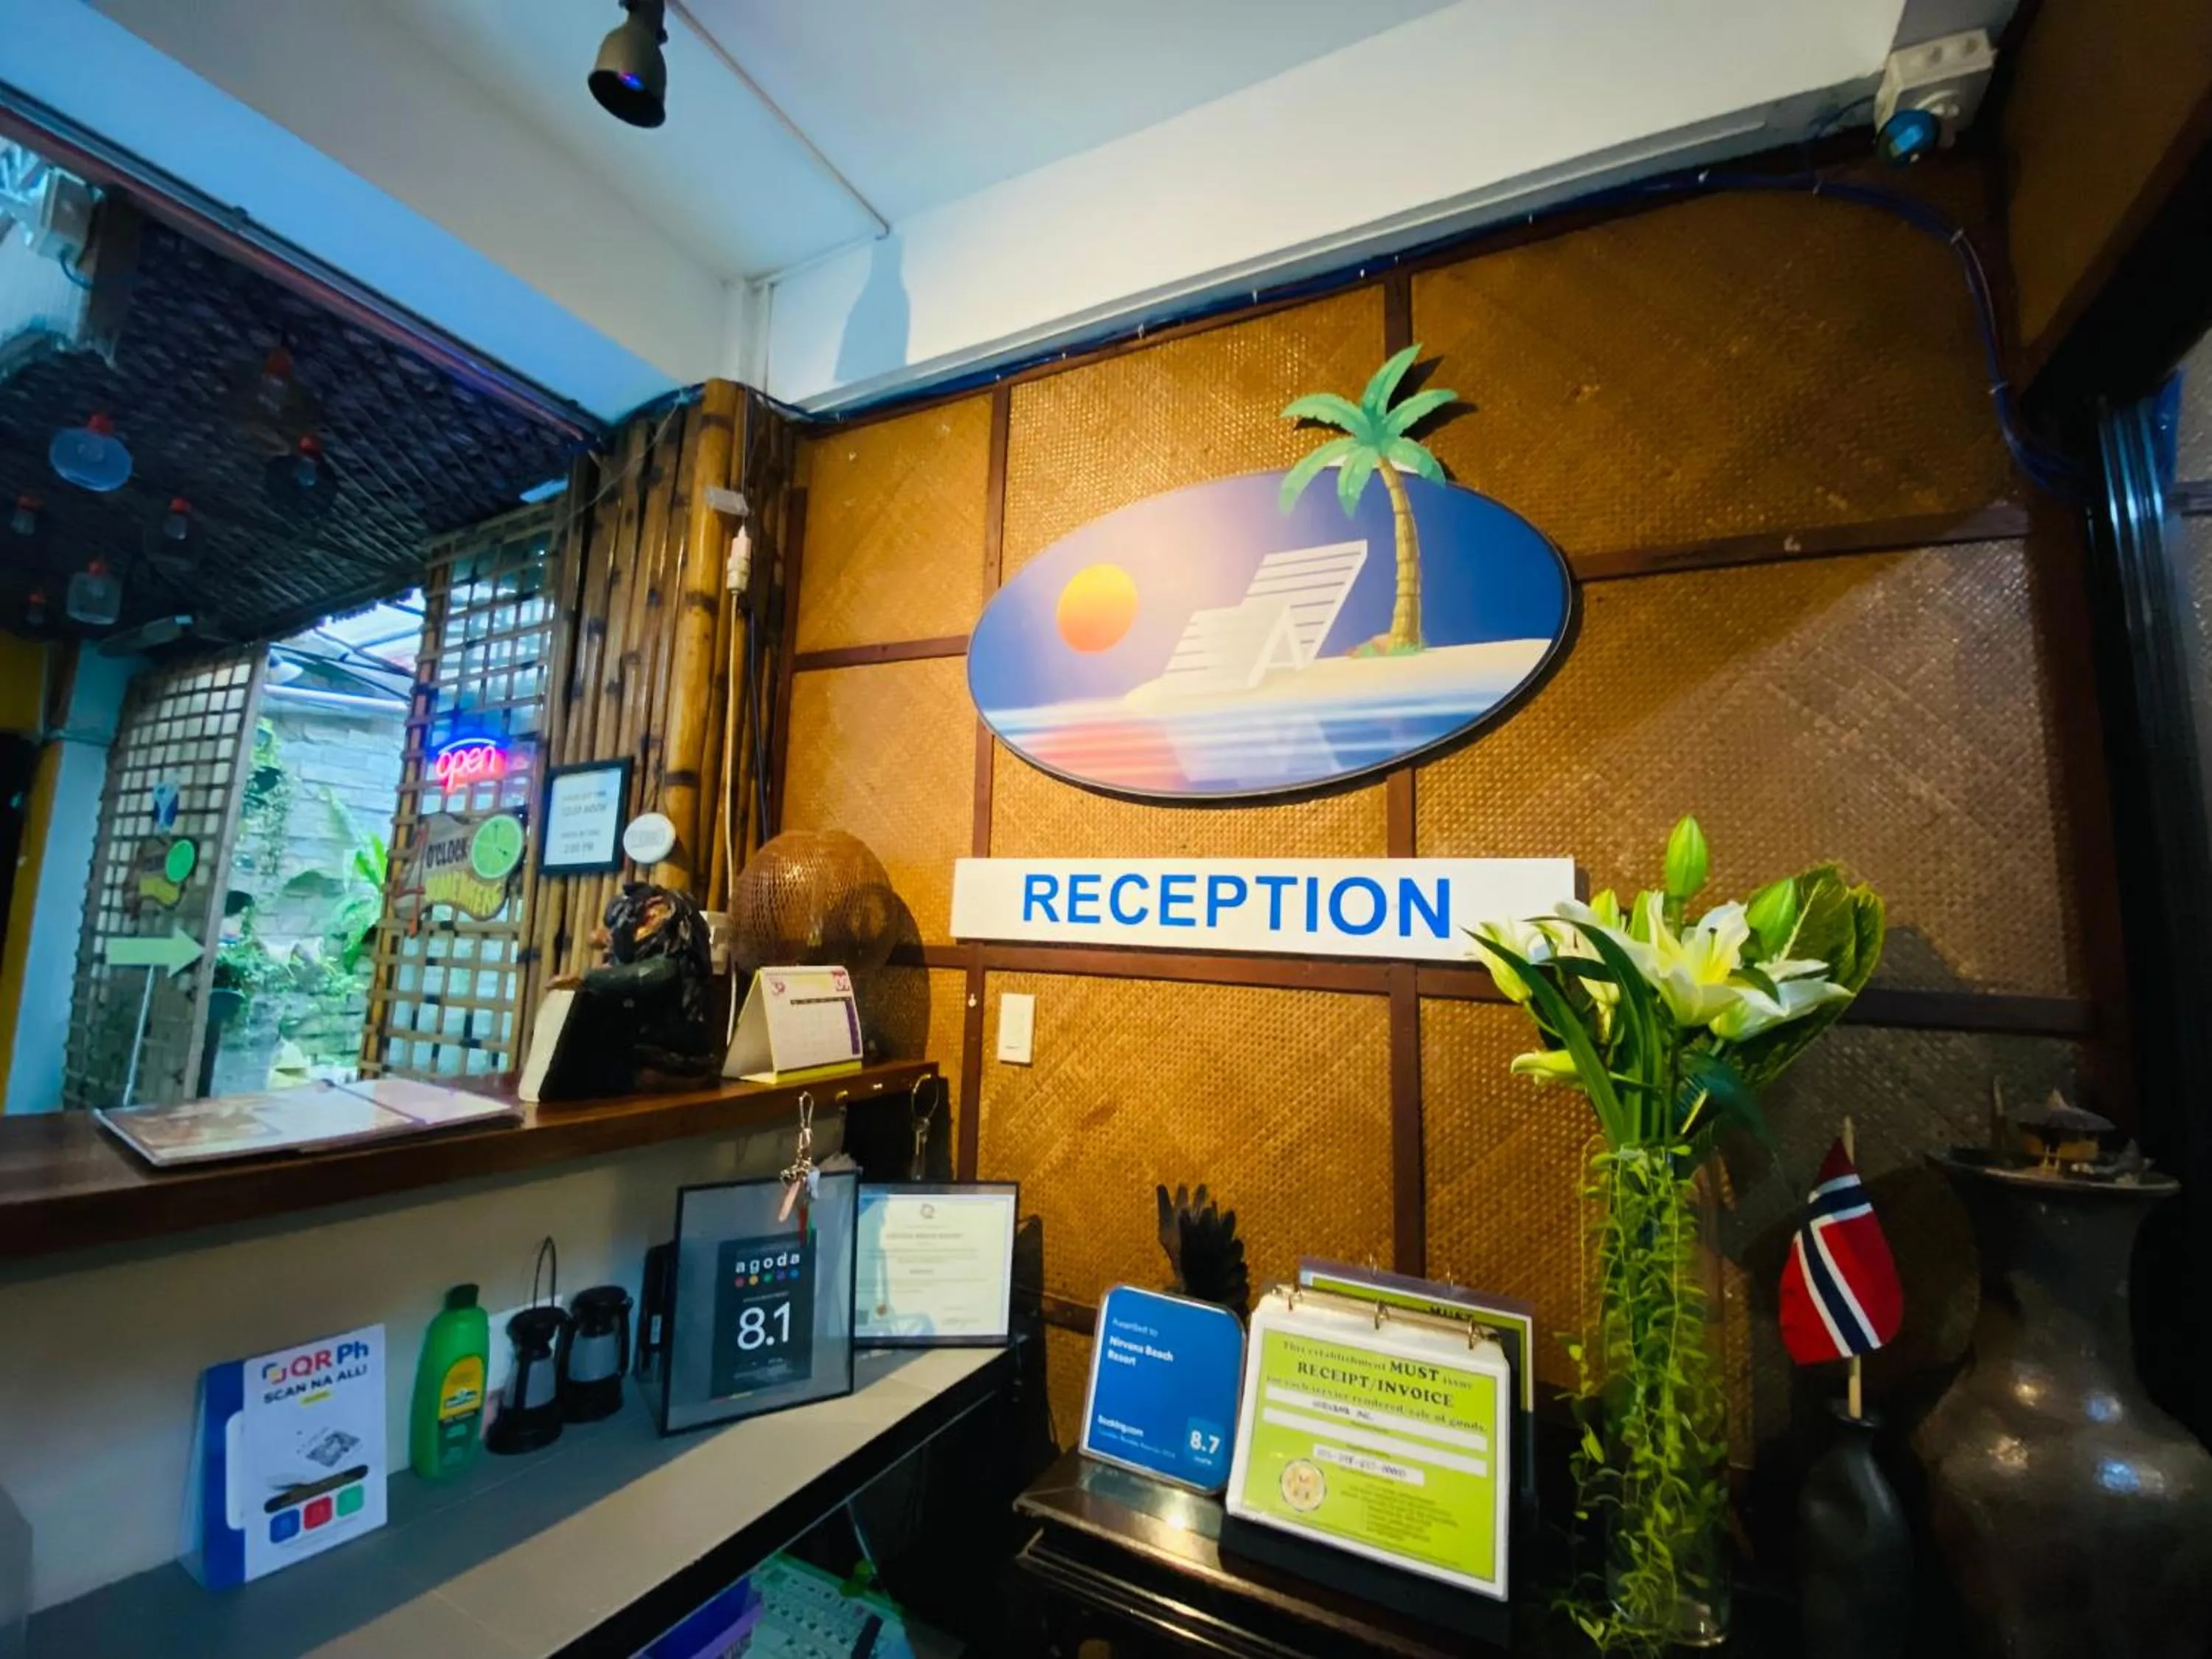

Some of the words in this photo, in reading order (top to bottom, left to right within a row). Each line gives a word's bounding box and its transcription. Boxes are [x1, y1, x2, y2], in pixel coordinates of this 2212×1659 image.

[436, 745, 497, 792] open
[1022, 873, 1452, 939] RECEPTION
[735, 1251, 800, 1274] agoda
[737, 1301, 790, 1351] 8.1
[291, 1349, 332, 1377] QR
[336, 1340, 369, 1365] Ph
[1107, 1349, 1137, 1366] Resort
[1145, 1343, 1174, 1363] Beach
[1297, 1360, 1455, 1408] RECEIPT/INVOICE
[1390, 1360, 1440, 1382] MUST
[263, 1382, 307, 1404] SCAN
[310, 1375, 333, 1390] NA
[1189, 1429, 1221, 1455] 8.7
